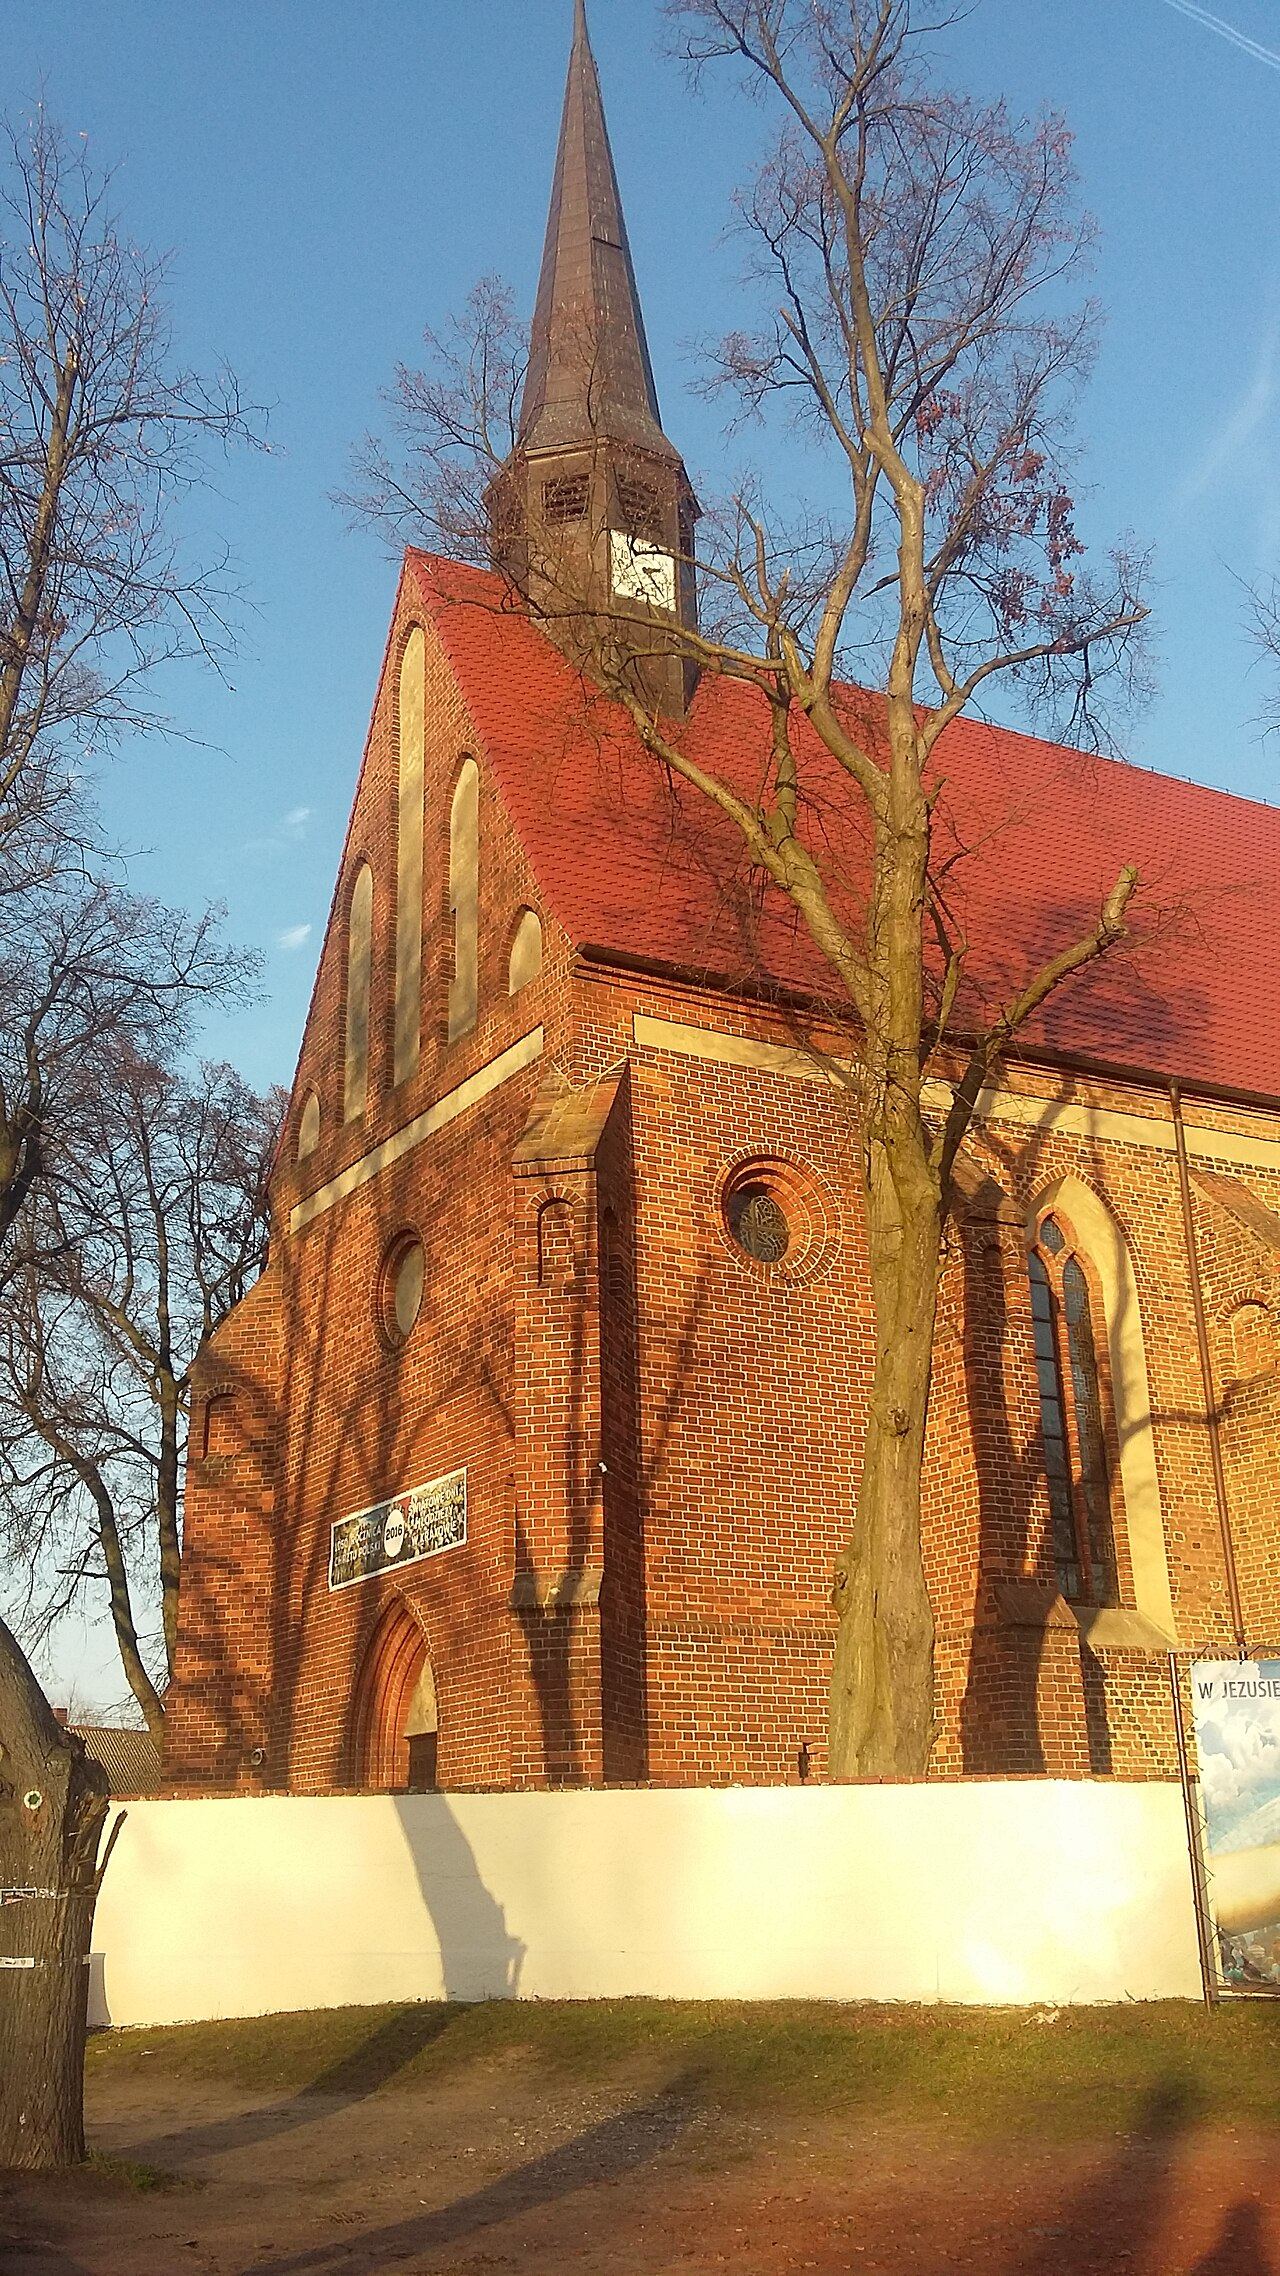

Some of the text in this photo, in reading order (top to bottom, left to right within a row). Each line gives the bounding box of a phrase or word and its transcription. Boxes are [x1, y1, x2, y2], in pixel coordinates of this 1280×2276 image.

[385, 1524, 403, 1541] 2016
[359, 1539, 380, 1557] POLSKI
[1198, 1681, 1280, 1699] W JEZUSIE
